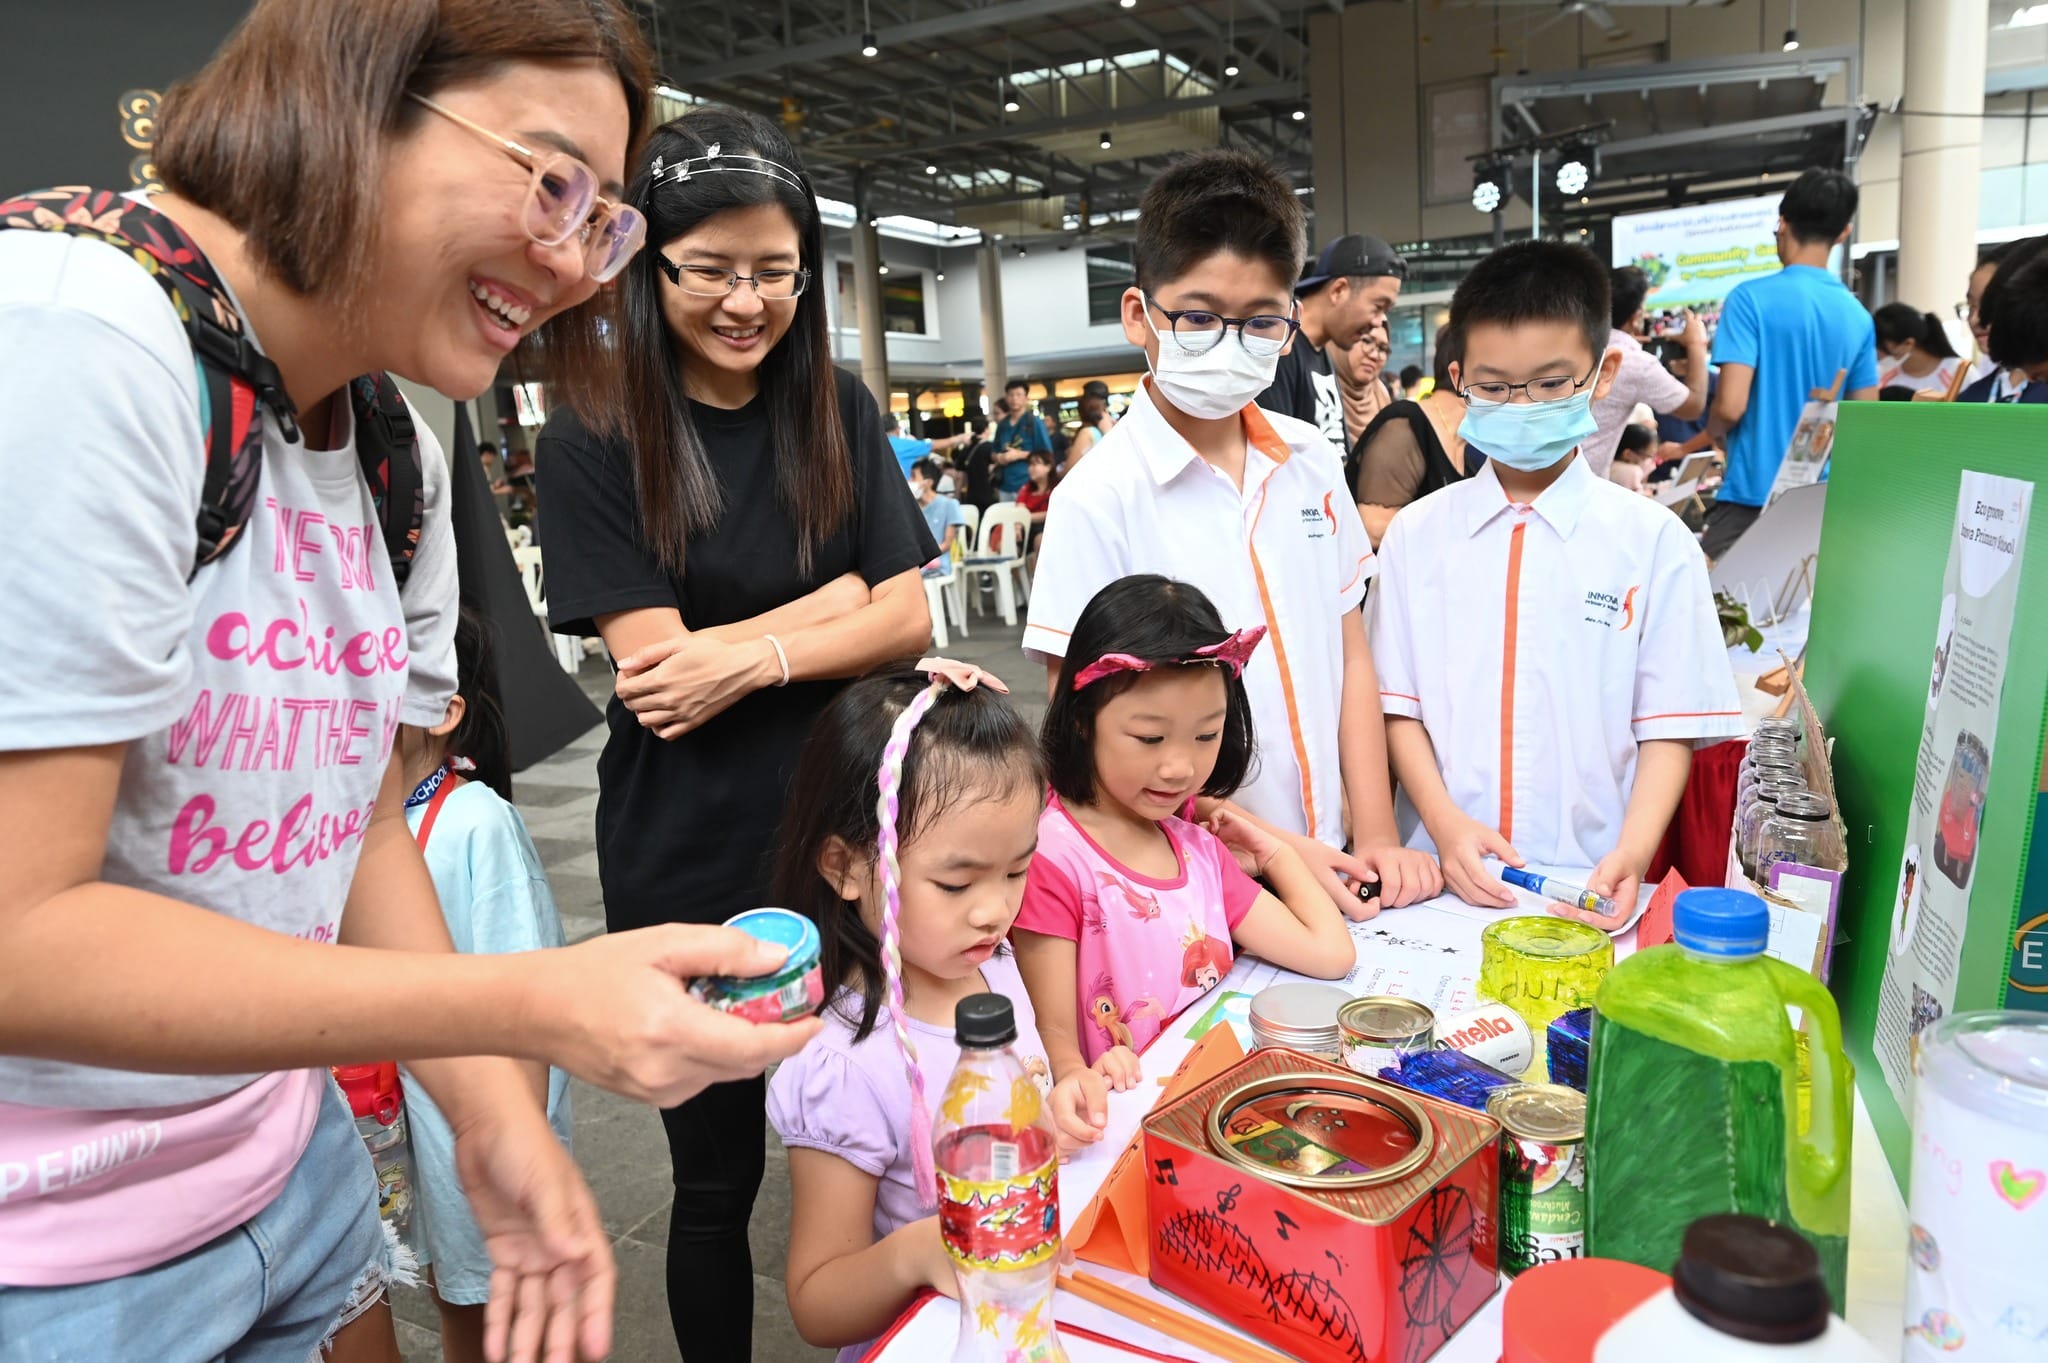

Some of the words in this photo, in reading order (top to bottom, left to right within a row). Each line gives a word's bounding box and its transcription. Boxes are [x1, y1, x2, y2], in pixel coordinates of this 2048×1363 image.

[167, 689, 312, 771] WHAT
[311, 697, 378, 770] THE
[1434, 1017, 1514, 1051] nutella
